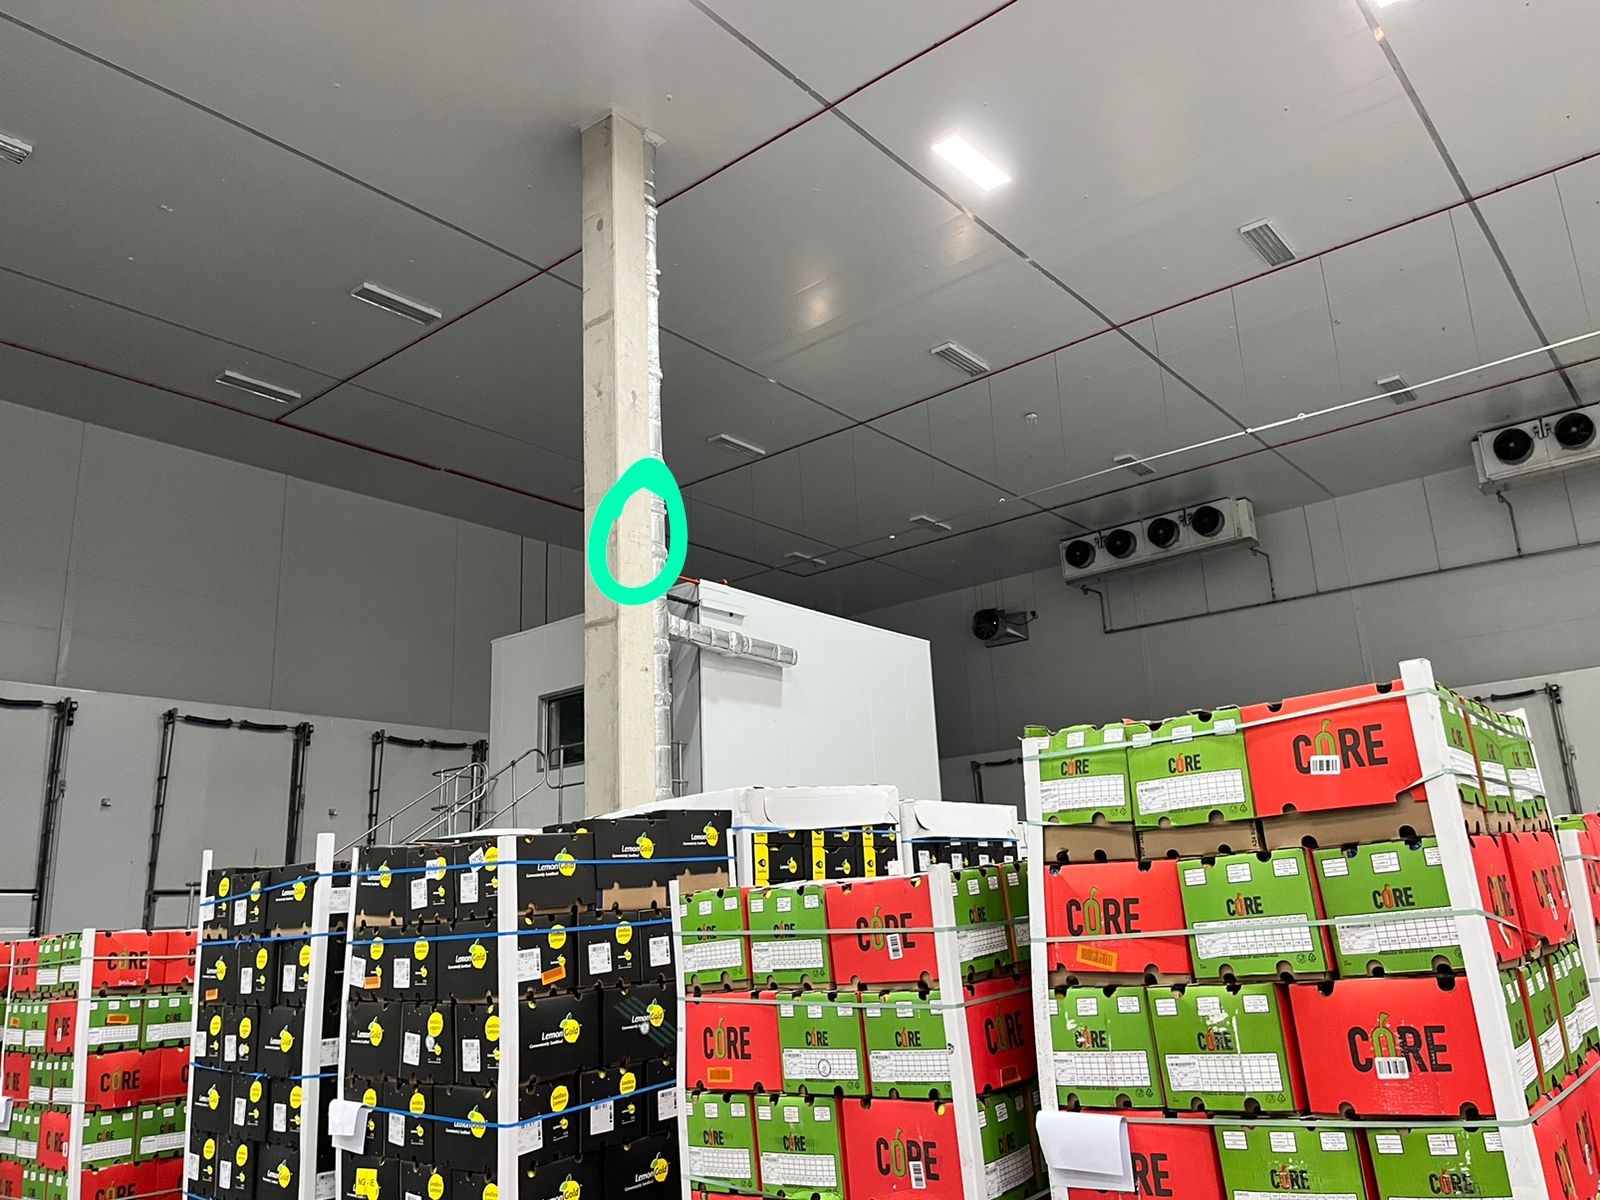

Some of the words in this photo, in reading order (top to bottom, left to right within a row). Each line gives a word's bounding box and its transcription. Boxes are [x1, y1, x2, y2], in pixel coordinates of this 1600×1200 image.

[1292, 718, 1388, 775] CORE
[1060, 757, 1090, 777] CORE
[1168, 752, 1202, 776] CORE
[1226, 892, 1264, 917] CORE
[1372, 883, 1416, 909] CORE
[969, 903, 987, 925] CORE
[1066, 886, 1142, 937] CORE
[107, 947, 148, 971] CORE
[703, 1016, 751, 1060] CORE
[805, 1028, 829, 1047] CORE
[895, 1027, 921, 1047] CORE
[984, 1006, 1025, 1056] CORE
[1075, 1026, 1107, 1050] CORE
[1198, 1028, 1234, 1051] CORE
[1347, 1012, 1453, 1073] CORE
[101, 1066, 141, 1092] CORE
[703, 1127, 724, 1146] CORE
[783, 1132, 806, 1152] CORE
[1269, 1164, 1310, 1190] CORE
[1428, 1167, 1475, 1196] CORE
